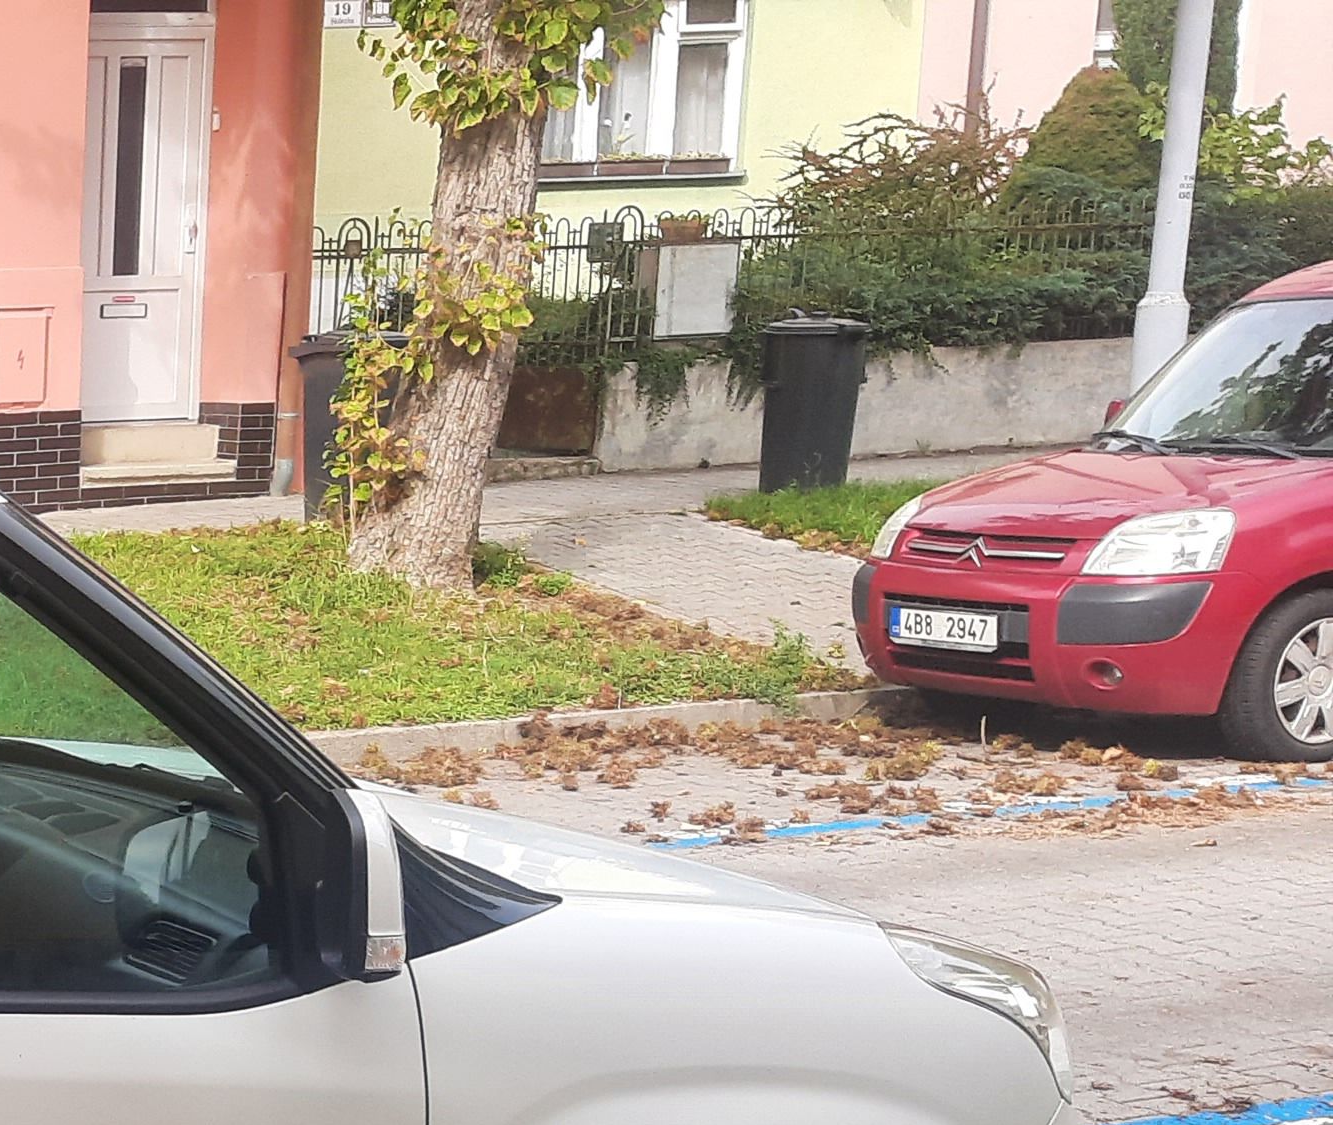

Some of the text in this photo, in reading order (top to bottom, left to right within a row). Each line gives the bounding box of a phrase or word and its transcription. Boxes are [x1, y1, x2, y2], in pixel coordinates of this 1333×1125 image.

[334, 3, 351, 15] 19
[904, 612, 988, 642] 4B8 2947
